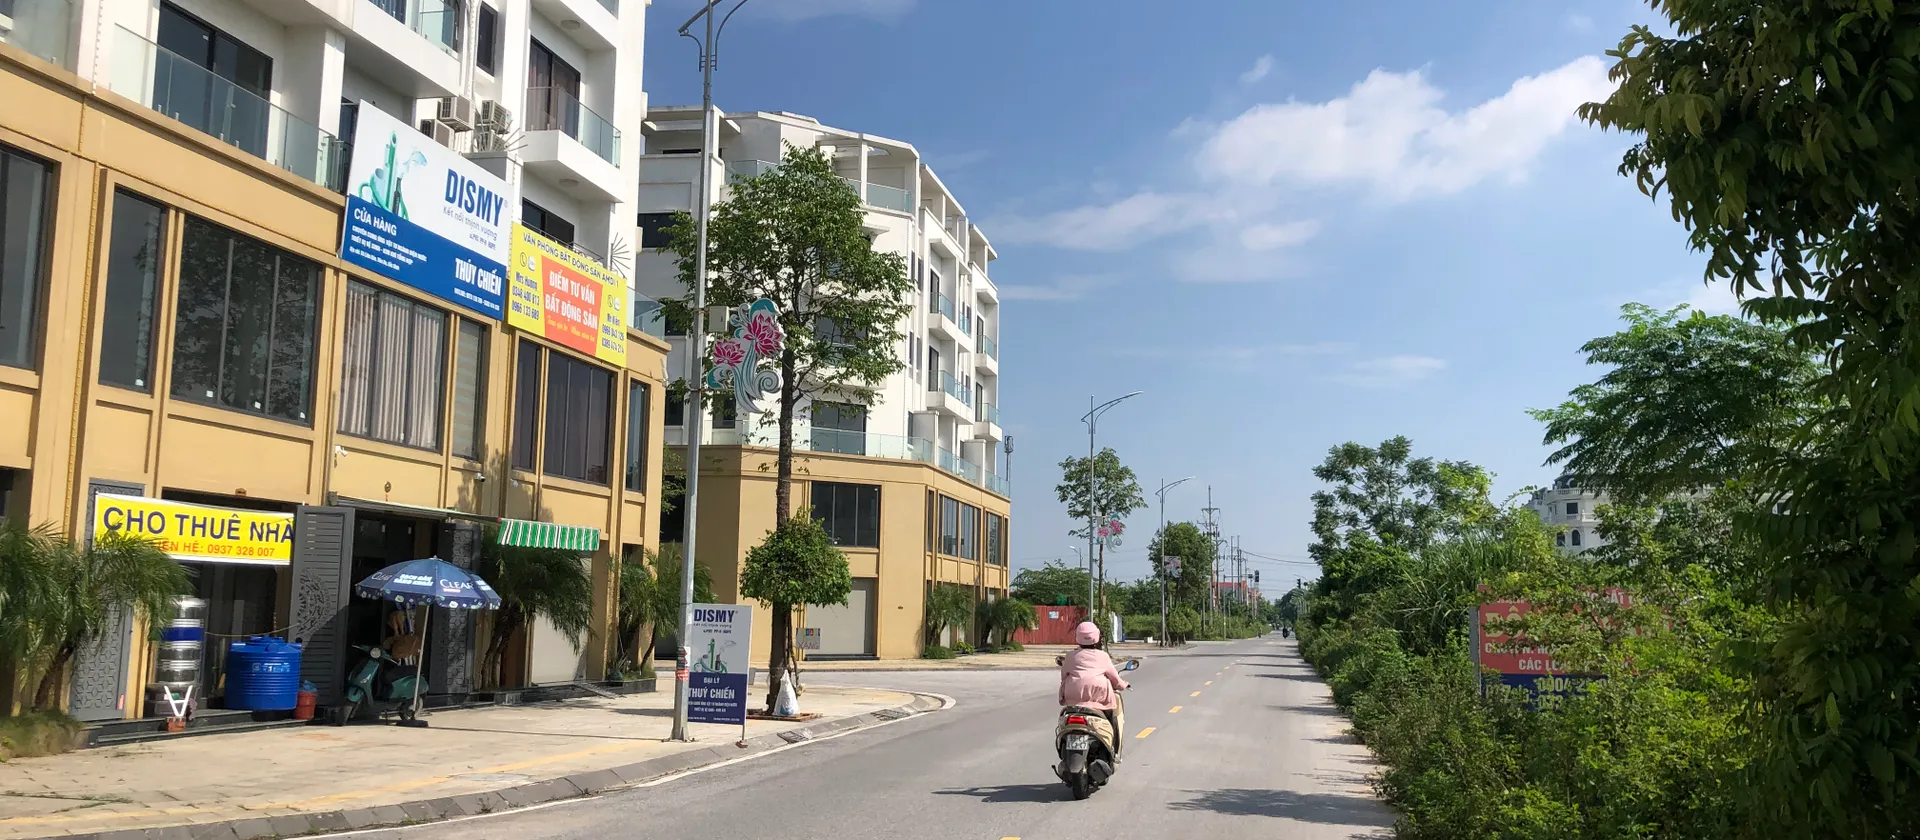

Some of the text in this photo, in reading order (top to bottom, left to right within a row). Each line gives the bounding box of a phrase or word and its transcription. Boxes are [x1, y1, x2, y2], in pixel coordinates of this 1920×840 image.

[445, 168, 504, 227] DISMY
[354, 207, 397, 236] CỬA HÀNG
[524, 232, 536, 246] VĂN
[537, 238, 559, 258] PHÒNG
[560, 248, 570, 263] BẤT
[572, 257, 589, 273] ĐỘNG
[590, 265, 600, 278] SẢN
[455, 257, 502, 296] THÚY CHIẾN
[549, 269, 595, 305] ĐIỂM TƯ VẤN
[545, 292, 560, 314] BẤT
[561, 300, 581, 323] ĐỘNG
[583, 308, 598, 330] SẢN
[104, 506, 294, 543] CHO THUÊ NHÀ
[207, 544, 232, 556] 0937
[236, 546, 254, 556] 328
[257, 547, 275, 557] 007
[440, 579, 474, 590] CLEAR
[694, 609, 735, 623] DISMY
[1519, 657, 1541, 670] CÁC
[710, 686, 735, 699] CHIẾN
